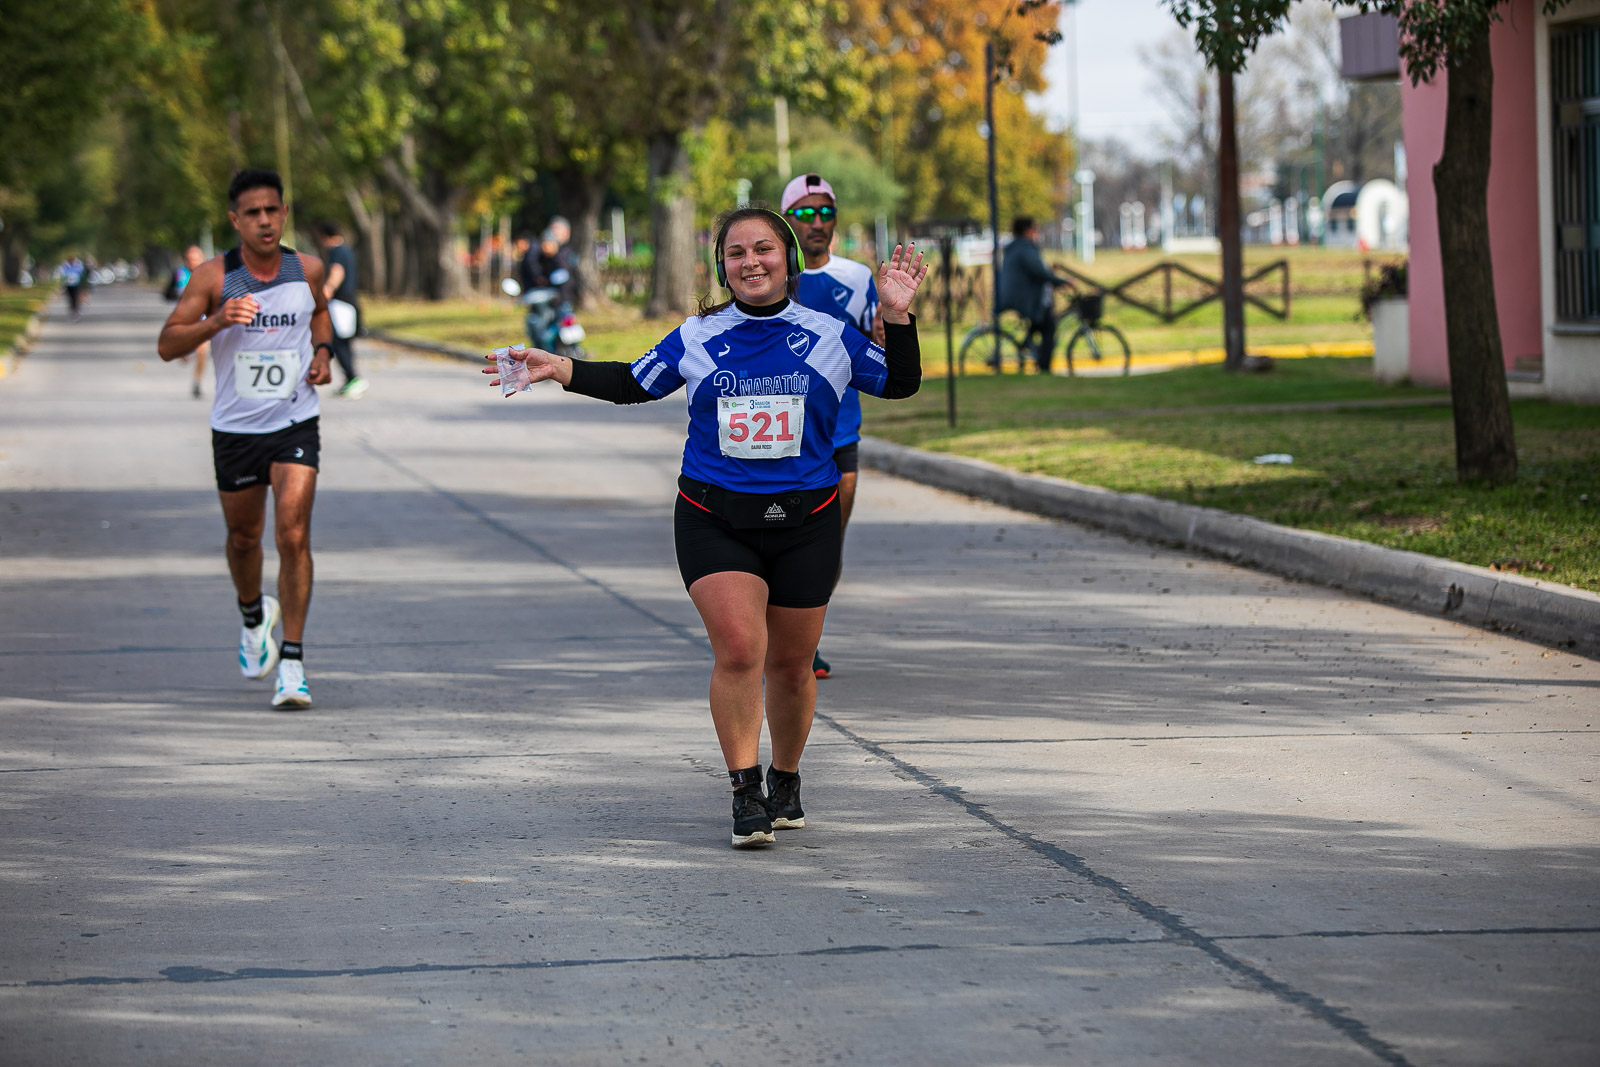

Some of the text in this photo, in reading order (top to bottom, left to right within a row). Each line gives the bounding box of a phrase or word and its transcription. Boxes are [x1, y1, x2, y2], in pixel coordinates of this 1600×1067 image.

[250, 365, 285, 387] 70
[714, 370, 737, 397] 3
[739, 371, 810, 396] MARATÓN
[749, 399, 755, 410] 3
[729, 411, 794, 442] 521
